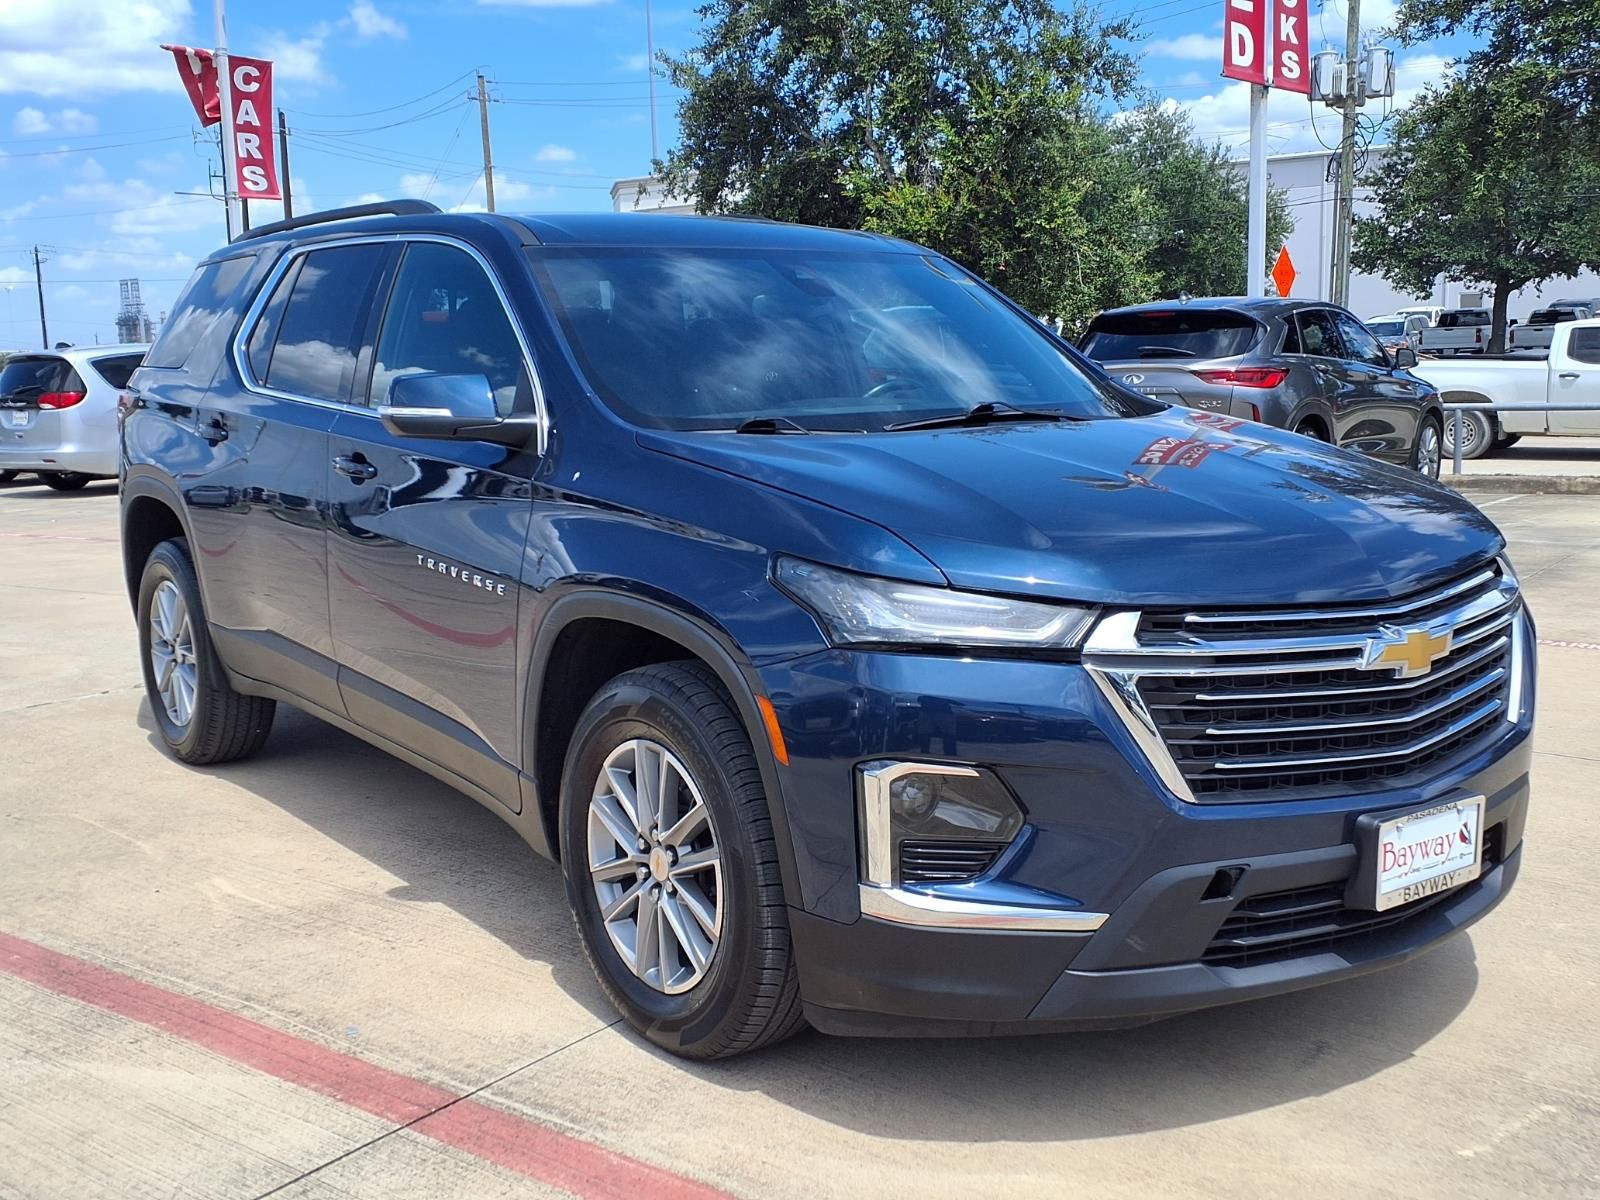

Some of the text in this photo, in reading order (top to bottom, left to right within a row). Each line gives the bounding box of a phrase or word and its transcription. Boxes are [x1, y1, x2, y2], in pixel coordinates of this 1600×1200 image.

[1230, 0, 1255, 67] D
[233, 65, 268, 192] CARS
[416, 554, 506, 596] TRAVERSE
[1406, 802, 1458, 824] PASADENA
[1381, 832, 1457, 877] Bayway
[1403, 872, 1457, 902] BAYWAY
